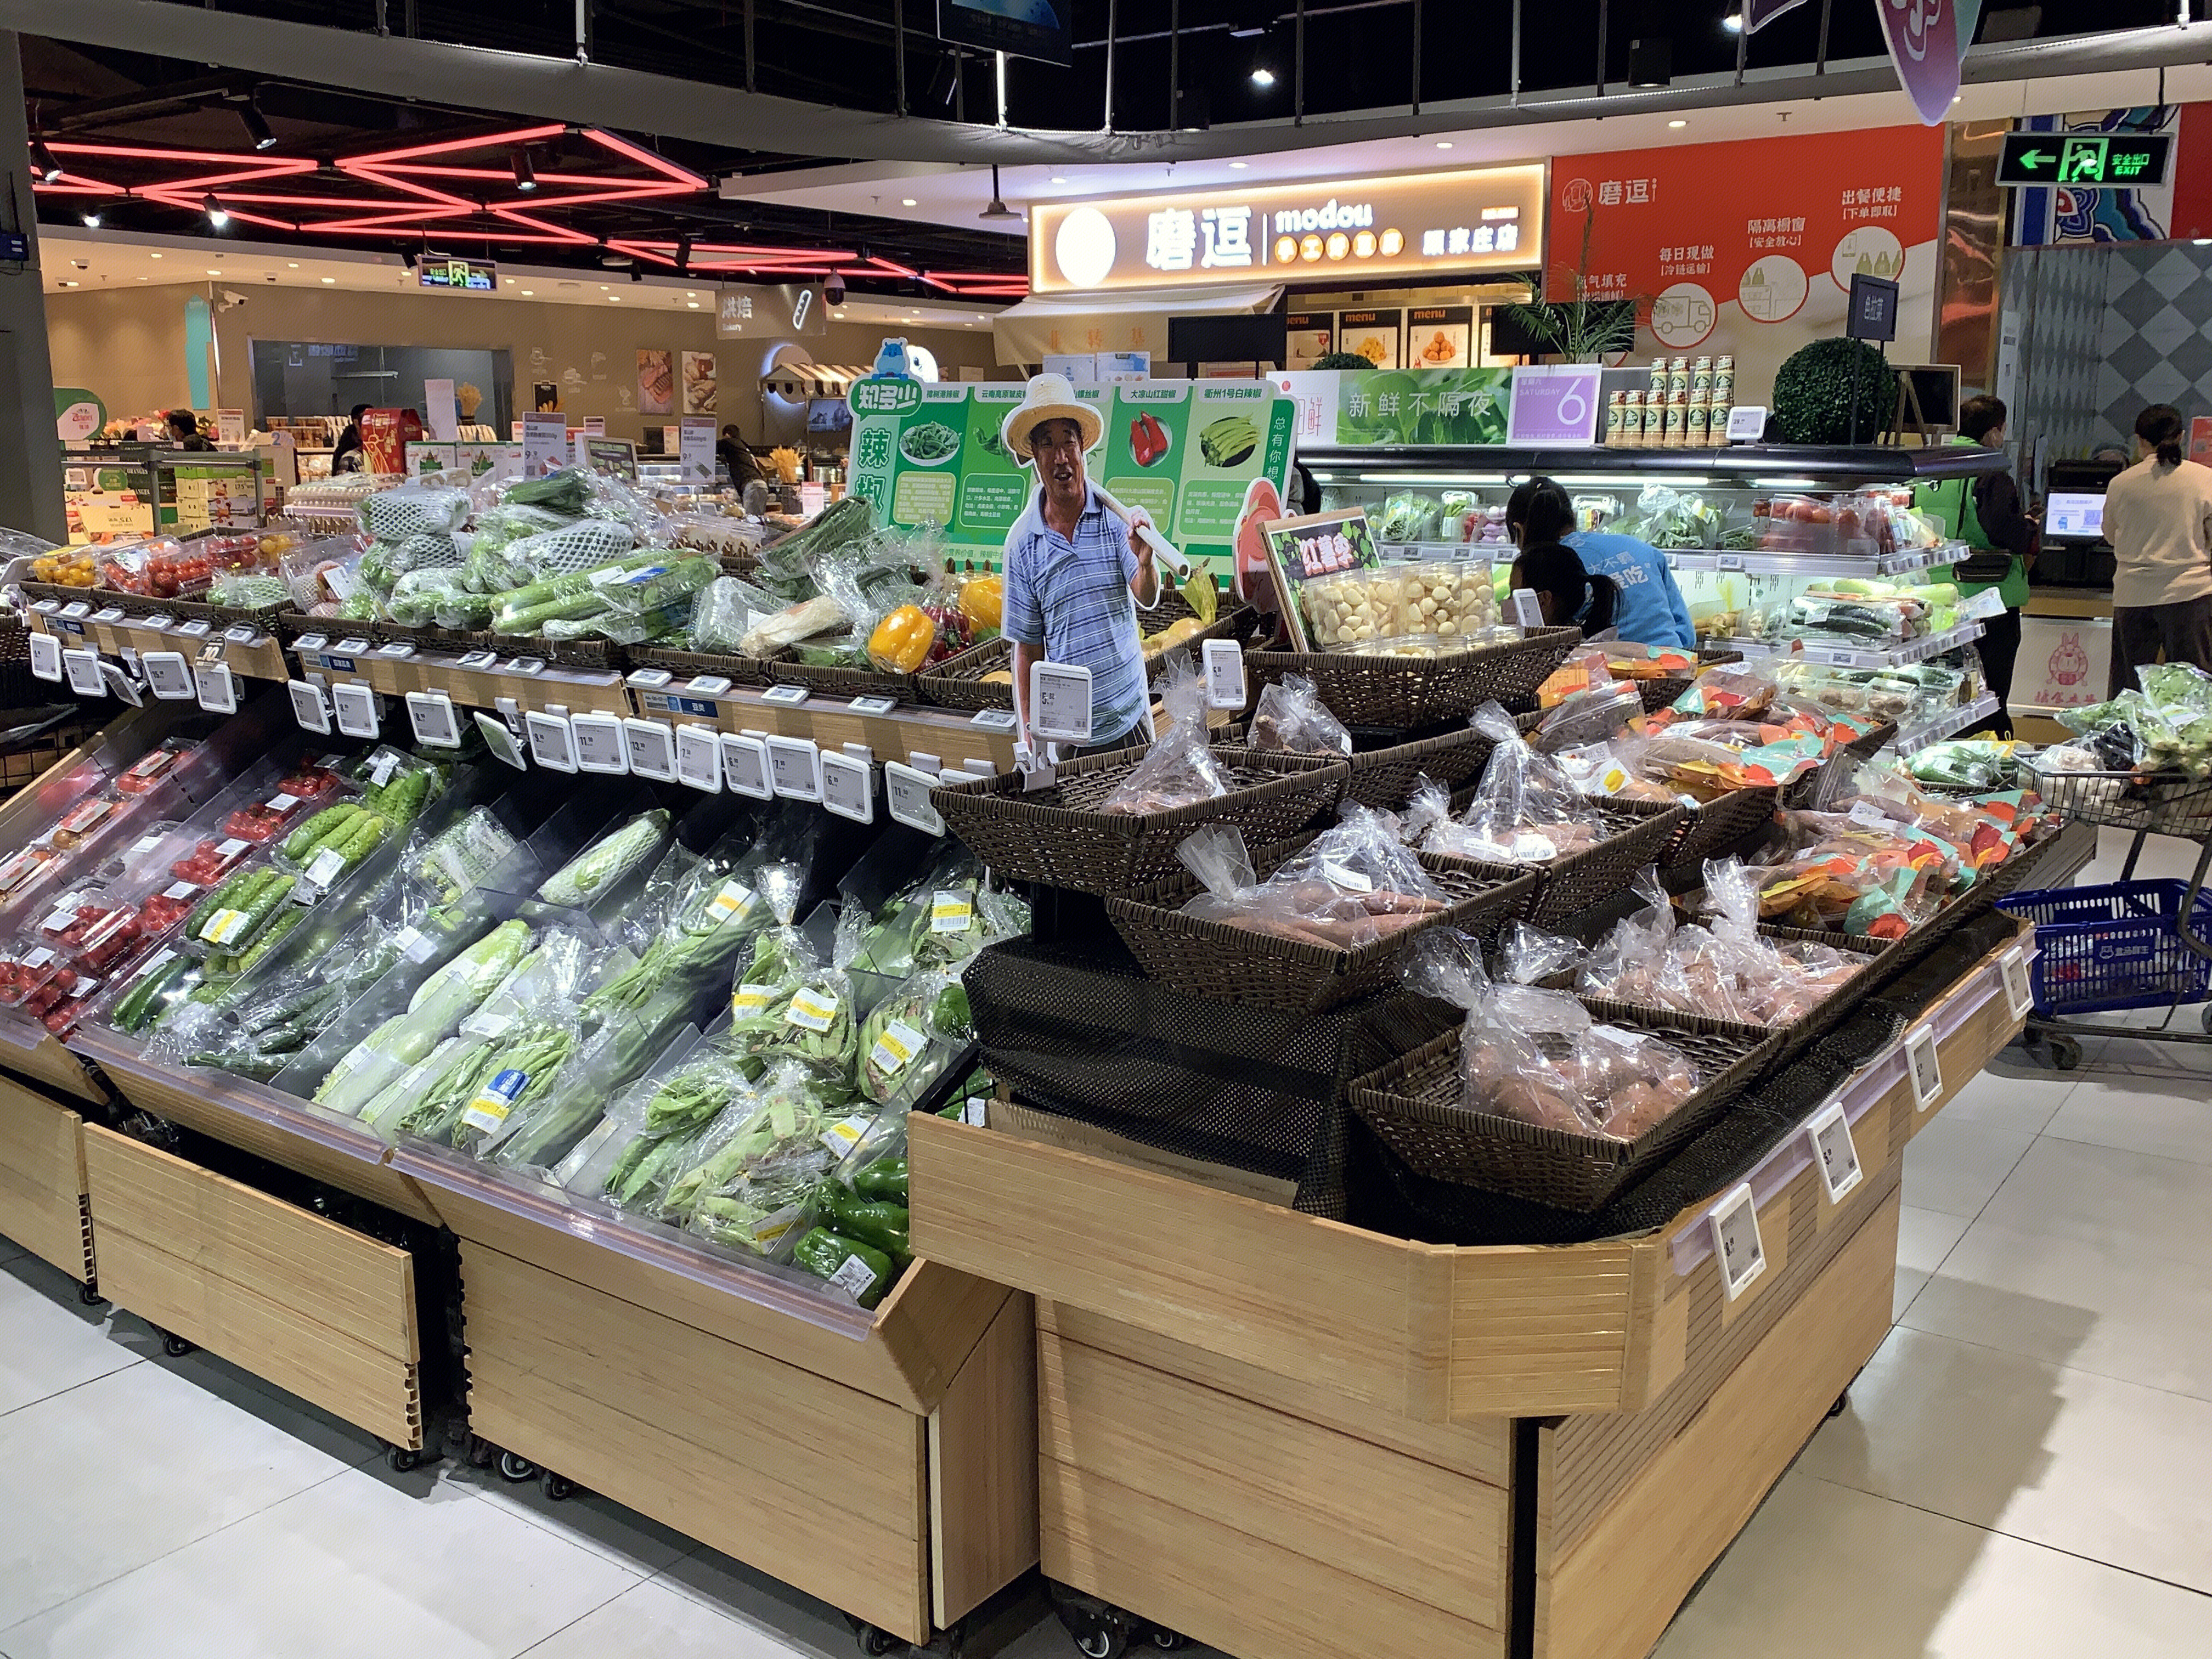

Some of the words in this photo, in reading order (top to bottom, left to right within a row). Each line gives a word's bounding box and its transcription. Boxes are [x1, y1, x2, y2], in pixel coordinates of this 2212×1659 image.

[2112, 154, 2150, 165] 安全出口
[2115, 166, 2141, 176] EXIT
[1599, 180, 1649, 206] 磨逗
[1842, 187, 1902, 205] 出餐便捷
[1274, 198, 1373, 233] modou
[1146, 207, 1252, 270] 磨逗
[1660, 245, 1714, 262] 每日现做
[722, 296, 752, 319] 烘焙
[1346, 312, 1375, 323] menu
[1414, 309, 1446, 319] menu
[859, 384, 917, 410] 知多少
[1349, 390, 1493, 419] 新鲜不隔夜
[1558, 378, 1586, 425] 6
[203, 646, 219, 662] 10
